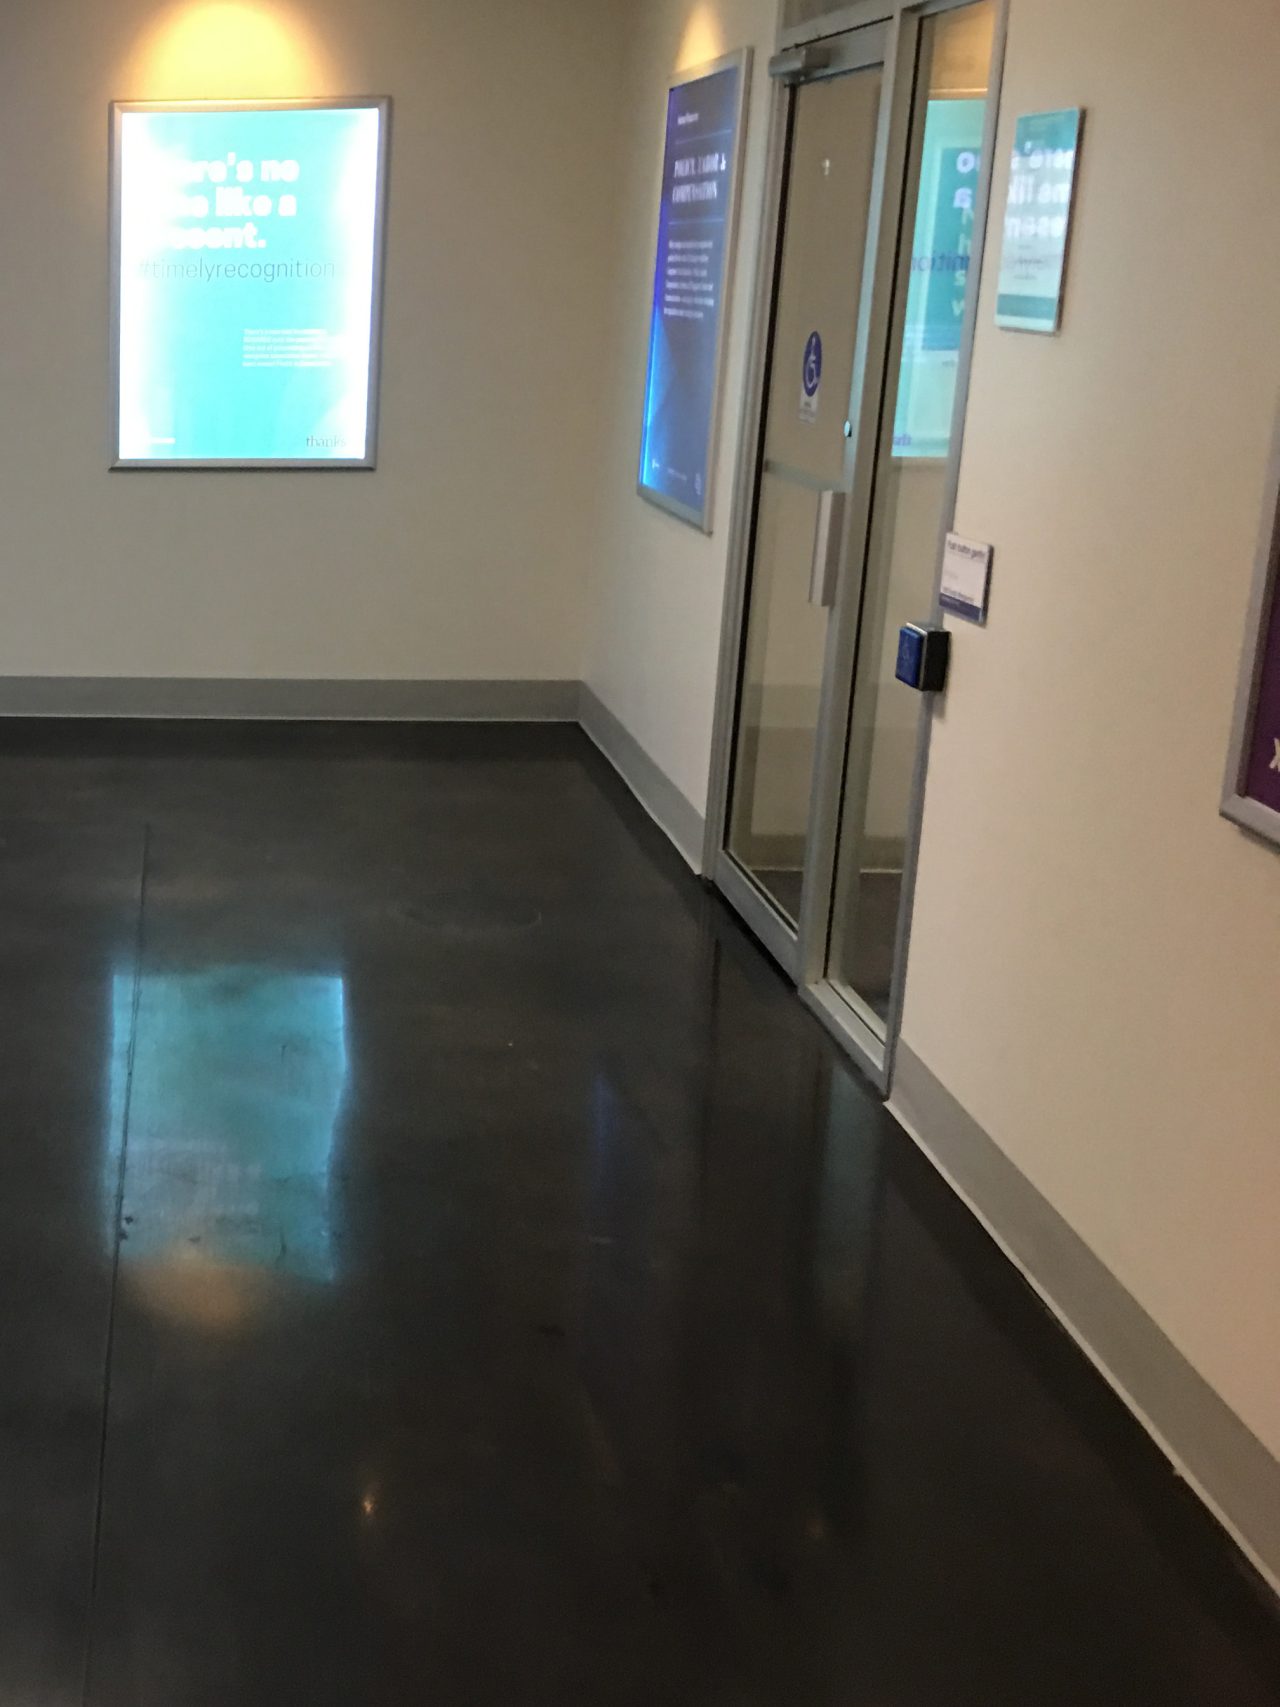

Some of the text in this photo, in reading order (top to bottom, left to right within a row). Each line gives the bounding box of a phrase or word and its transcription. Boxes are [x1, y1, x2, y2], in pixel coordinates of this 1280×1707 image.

[260, 158, 301, 183] no
[215, 186, 273, 217] like
[278, 194, 297, 217] a
[138, 255, 336, 283] #timelyrecognition
